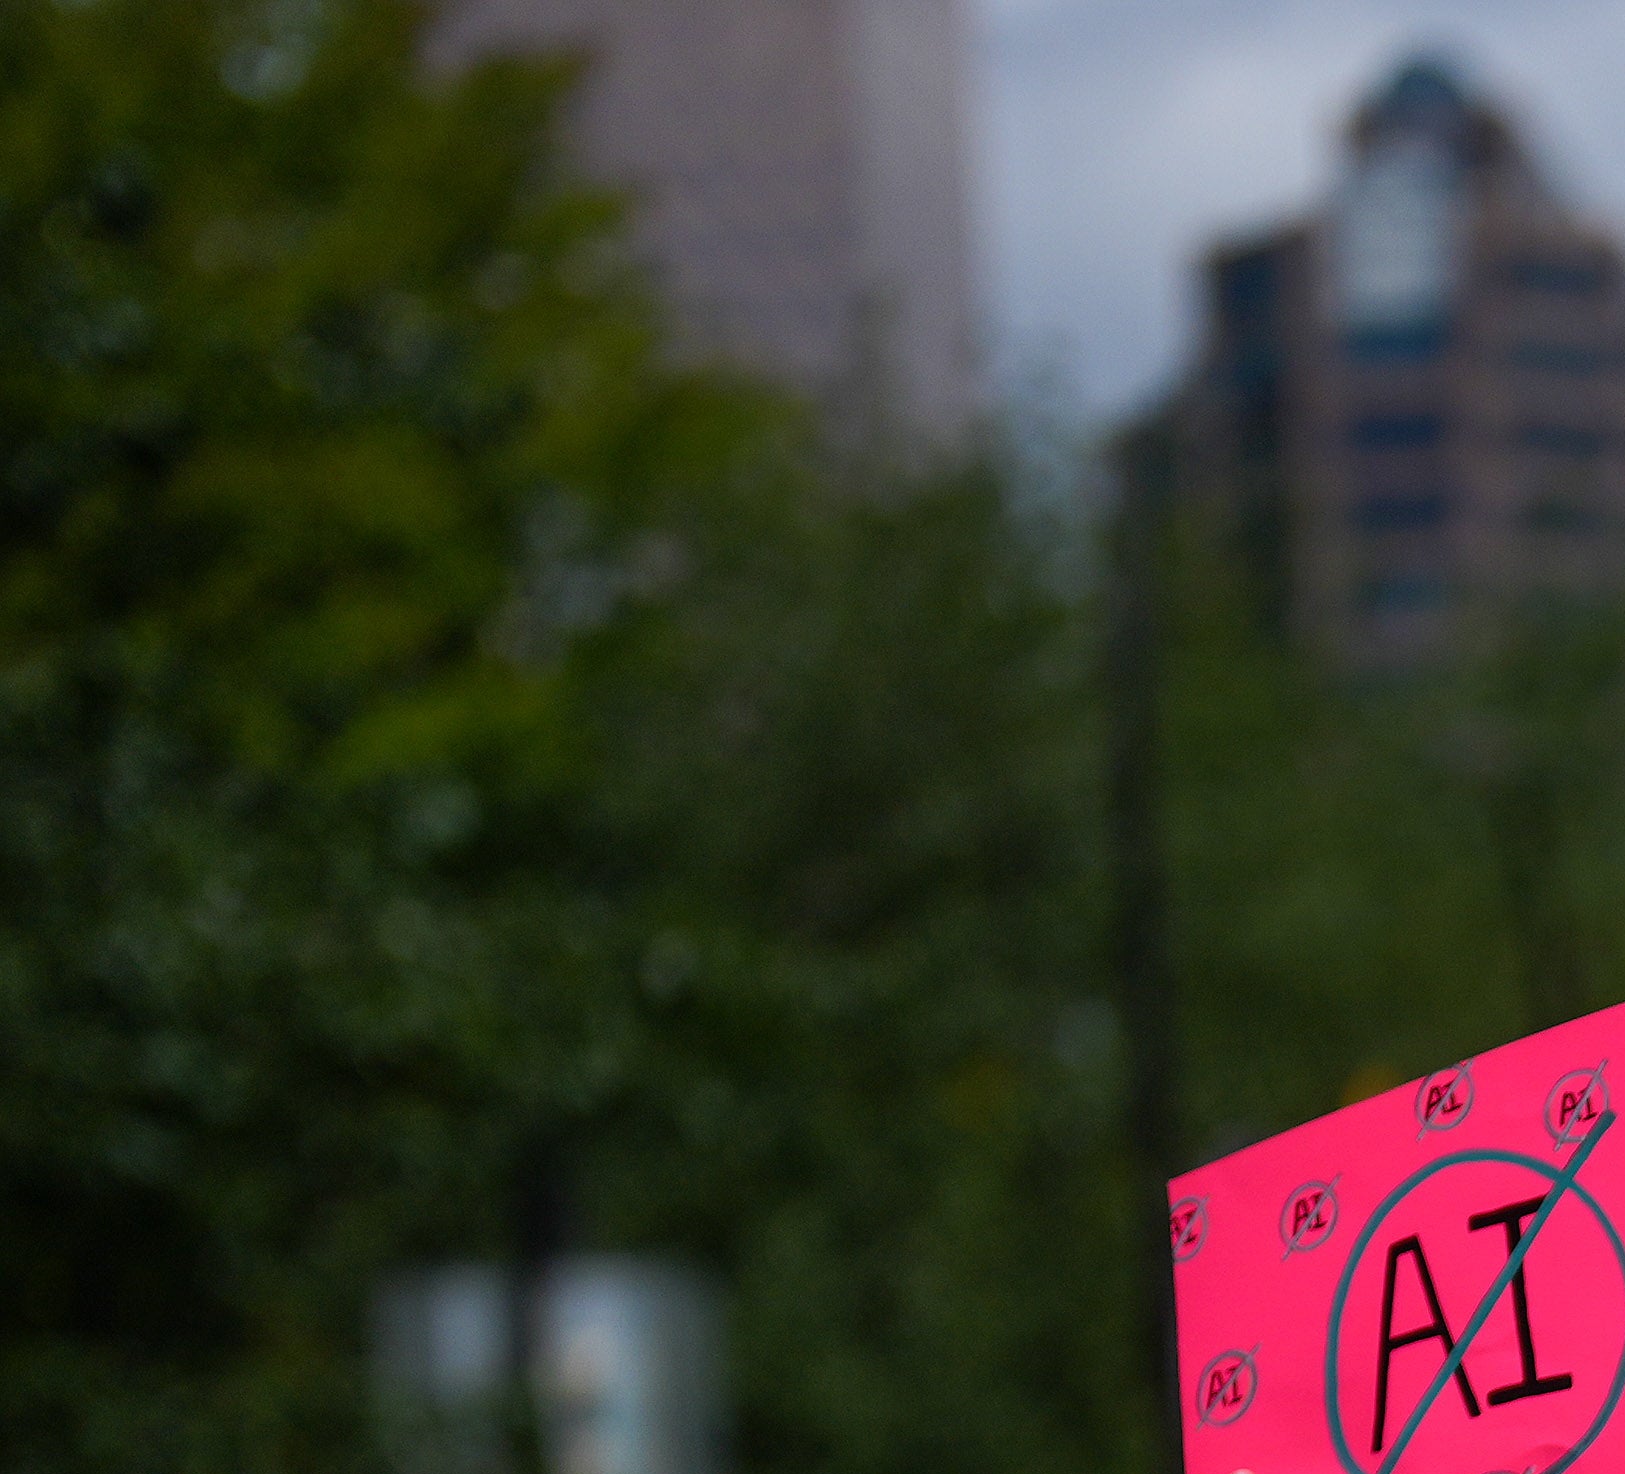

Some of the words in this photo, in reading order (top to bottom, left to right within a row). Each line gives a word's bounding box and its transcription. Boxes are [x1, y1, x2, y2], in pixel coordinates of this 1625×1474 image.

[1425, 1080, 1463, 1121] AI
[1559, 1087, 1598, 1126] AI
[1292, 1191, 1328, 1237] AI
[1371, 1193, 1573, 1454] AI
[1206, 1367, 1243, 1408] AI
